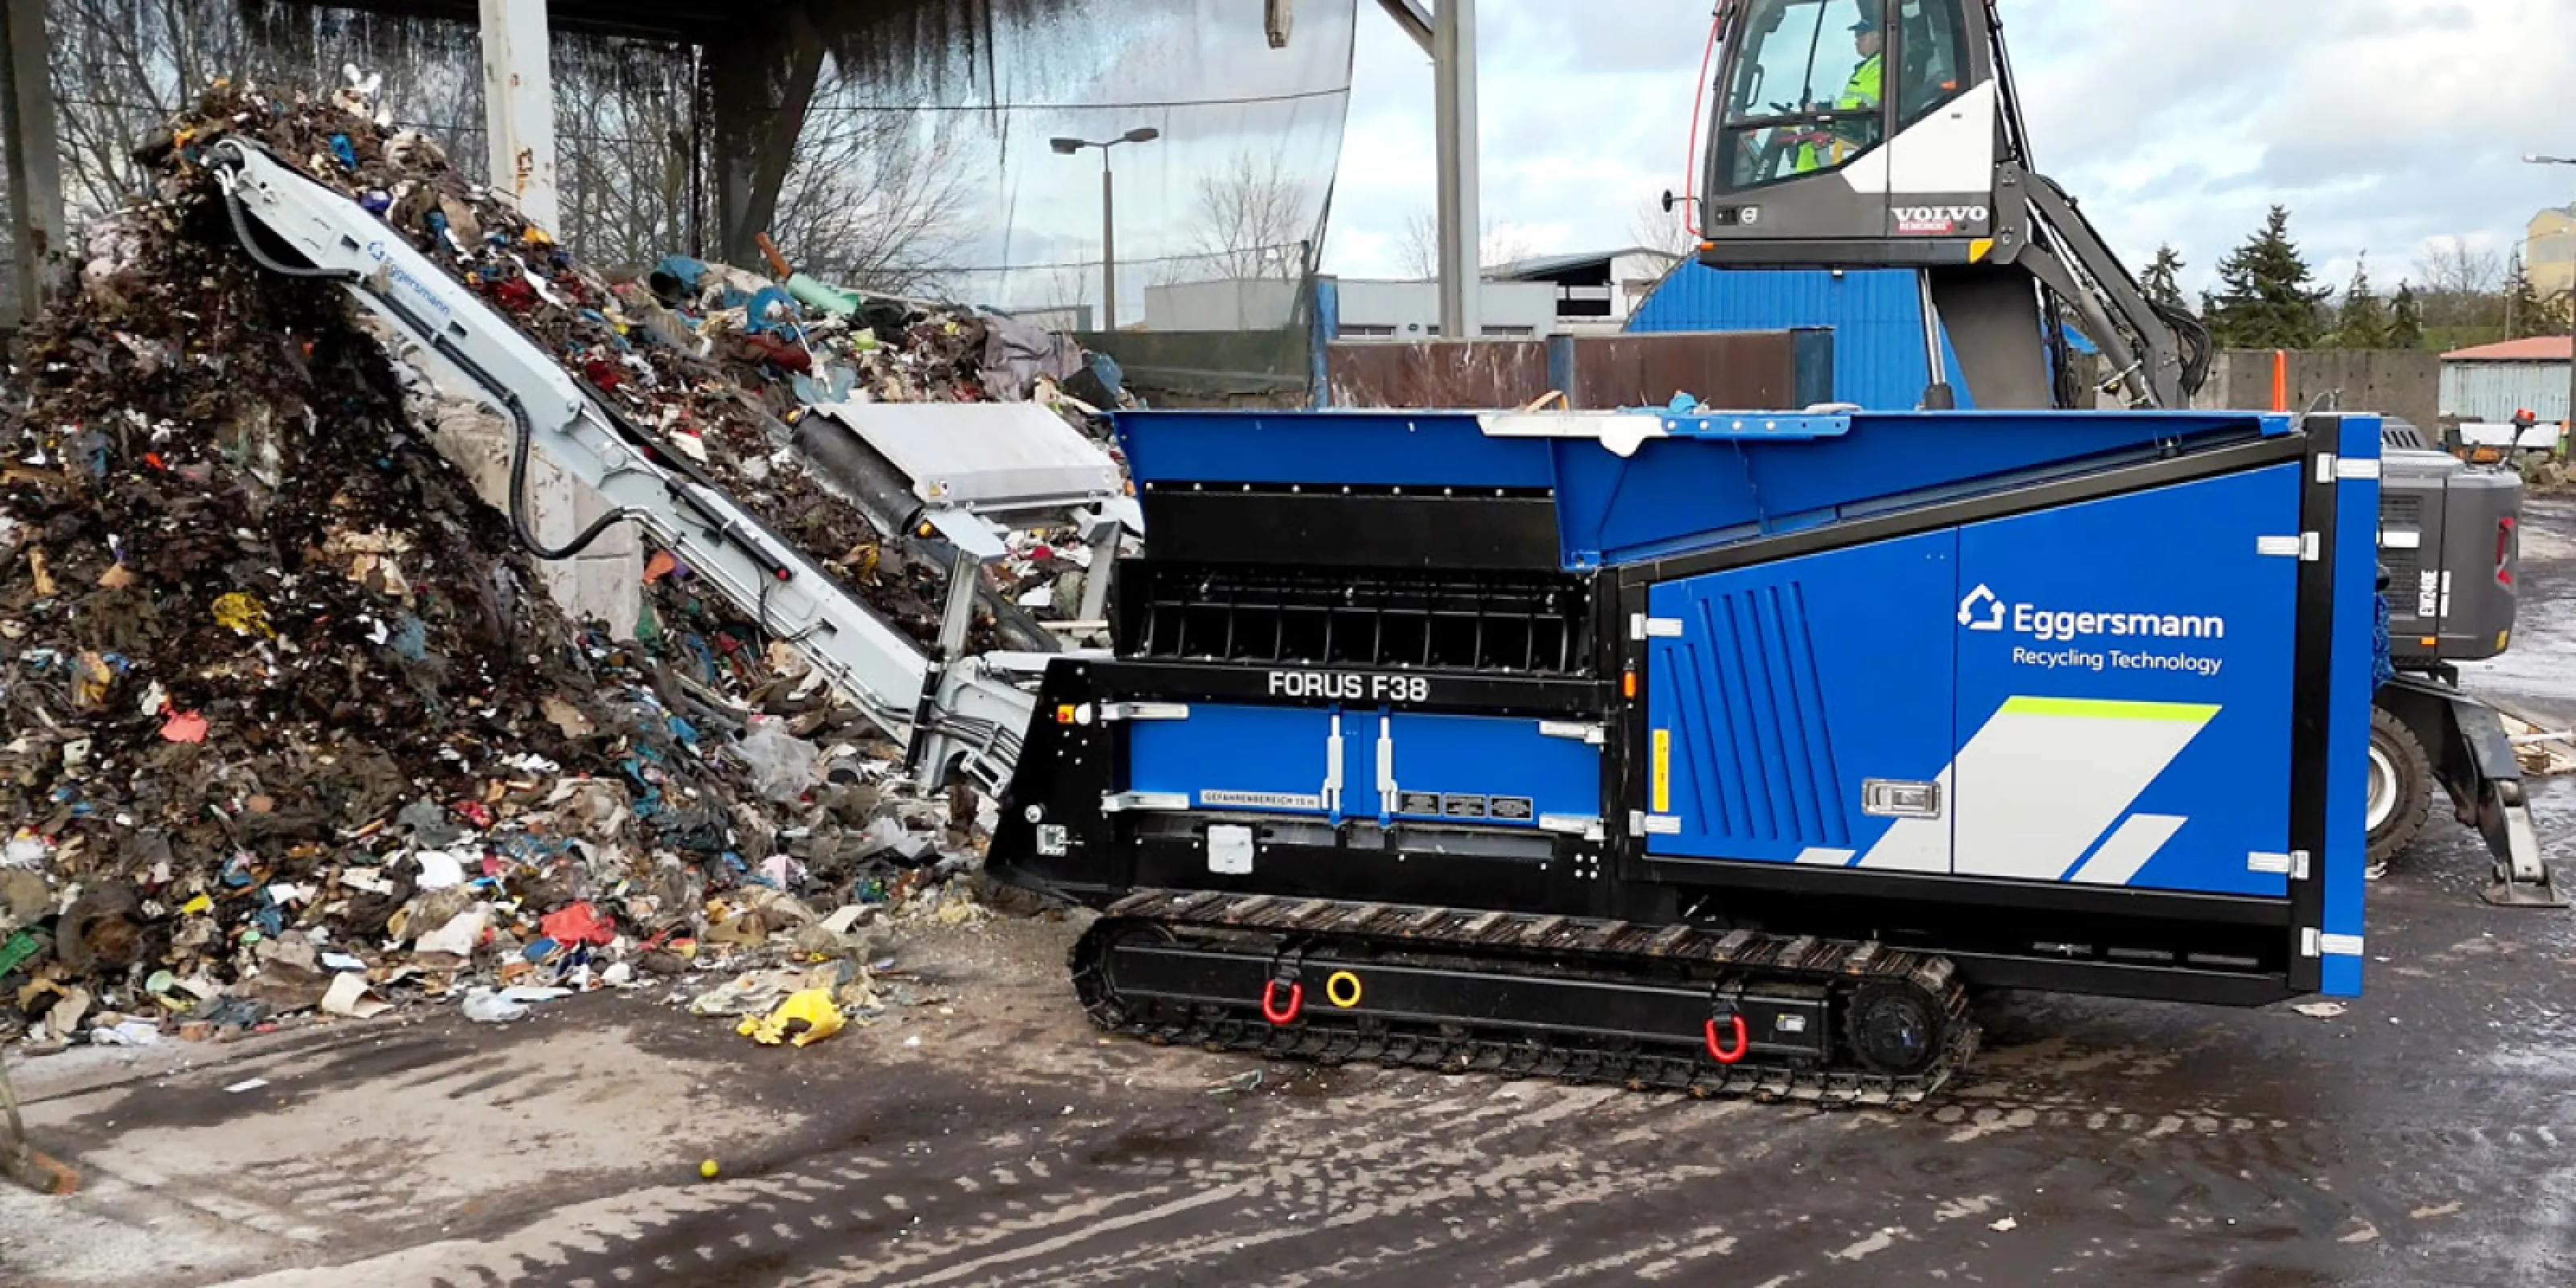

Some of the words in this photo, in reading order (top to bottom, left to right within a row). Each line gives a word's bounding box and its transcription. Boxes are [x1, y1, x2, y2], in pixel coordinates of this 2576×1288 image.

[1890, 205, 1988, 221] VOLVO
[2013, 603, 2224, 641] Eggersmann
[2013, 646, 2105, 671] Recycling
[2107, 649, 2223, 676] Technology
[1269, 671, 1362, 700] FORUS
[1371, 675, 1429, 702] F38
